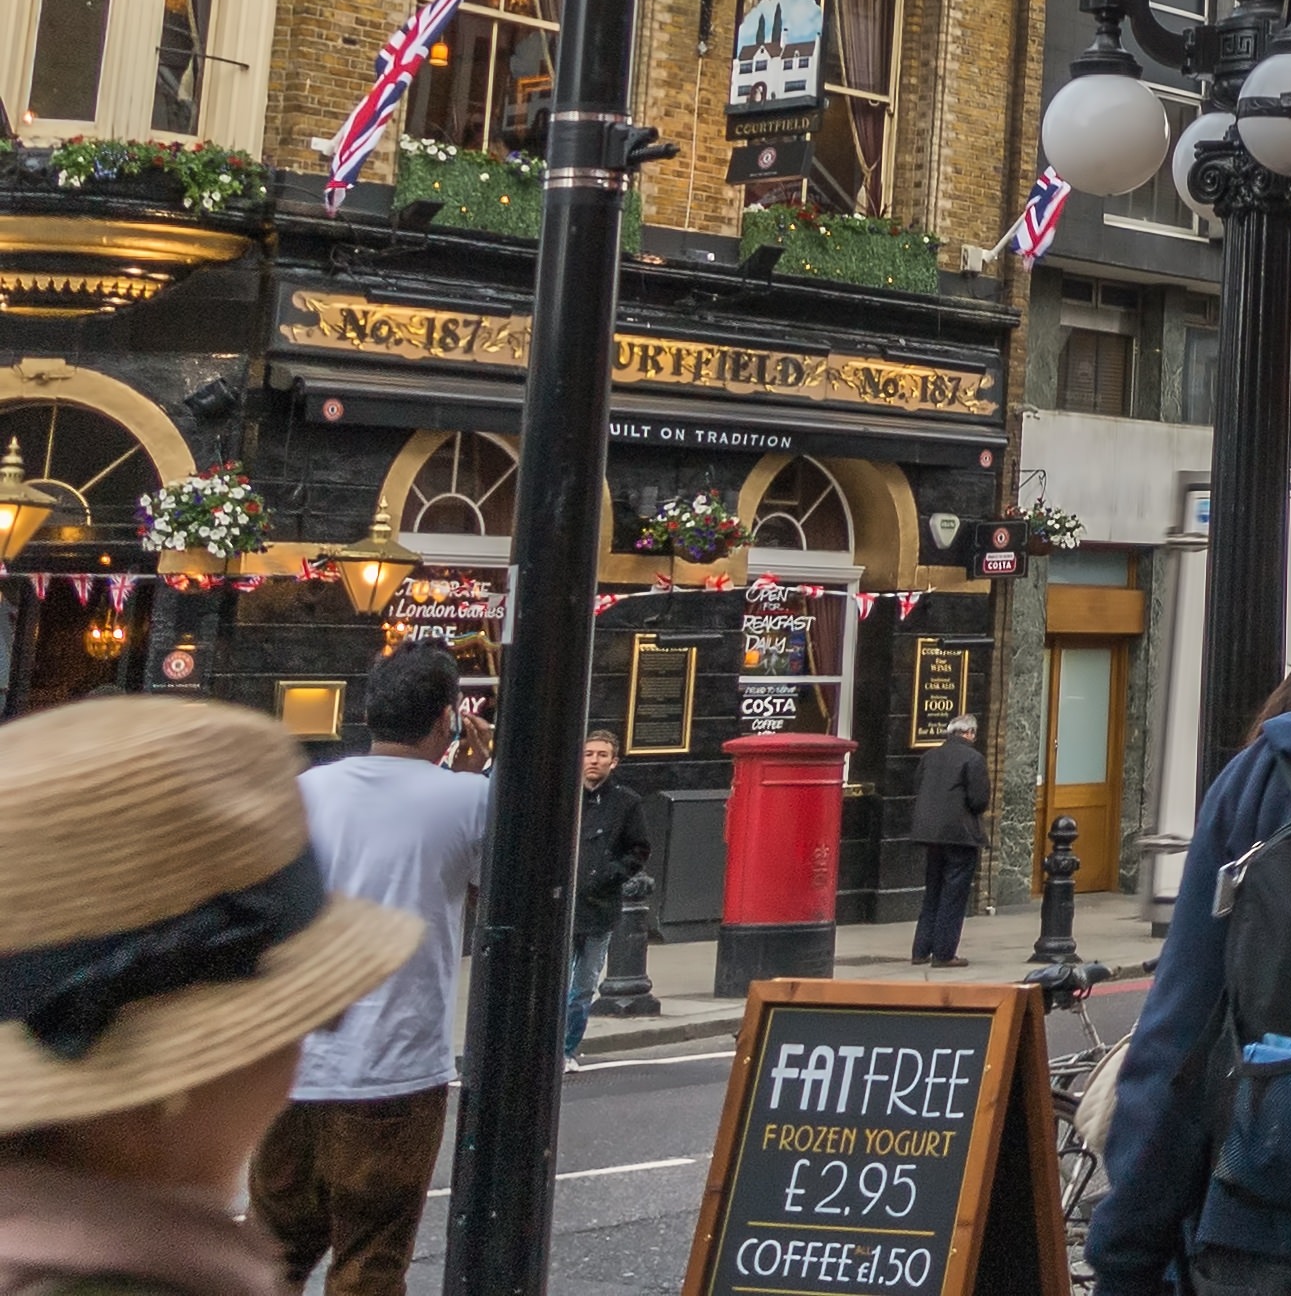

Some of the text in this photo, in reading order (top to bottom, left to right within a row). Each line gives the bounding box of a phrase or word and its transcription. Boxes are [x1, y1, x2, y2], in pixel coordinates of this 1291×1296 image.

[735, 117, 811, 135] COURTFIELD
[416, 314, 483, 354] 187
[919, 374, 962, 406] 187
[660, 427, 685, 441] ON
[695, 429, 792, 449] TRADITION
[987, 561, 1012, 570] COSTA
[746, 581, 789, 603] OPEN
[396, 598, 457, 618] London
[458, 601, 504, 619] Games
[742, 696, 796, 717] COSTA
[924, 700, 954, 712] FOOD
[762, 1123, 957, 1157] FROZEN YOGURT
[784, 1158, 918, 1217] £2.95
[736, 1237, 856, 1282] COFFEE
